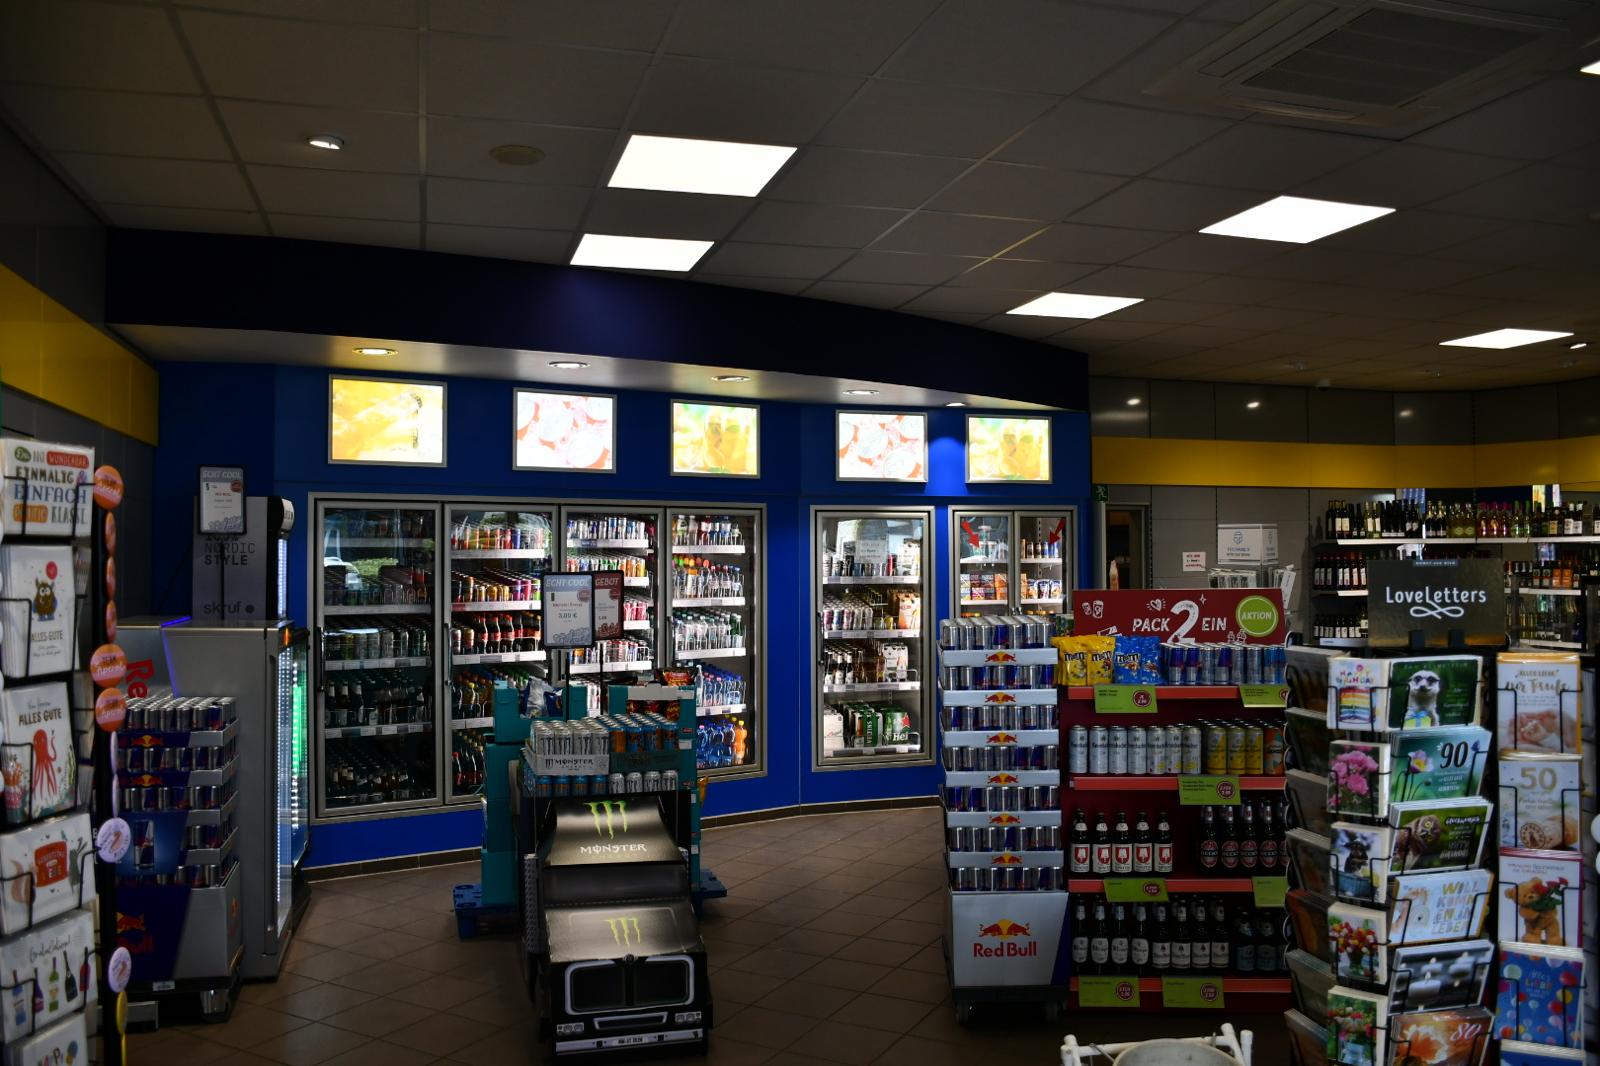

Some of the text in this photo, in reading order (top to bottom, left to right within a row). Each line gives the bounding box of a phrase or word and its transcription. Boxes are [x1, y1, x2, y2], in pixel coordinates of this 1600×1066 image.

[16, 466, 74, 484] EINMALIG
[222, 470, 242, 478] COOL
[204, 543, 256, 554] NORDIC
[204, 554, 248, 566] STYLE
[203, 601, 240, 614] skruf
[1133, 600, 1227, 644] PACK 2 EIN
[1241, 611, 1272, 620] AKTION
[19, 708, 62, 726] ALLES GUTE
[1440, 741, 1469, 769] 90
[555, 758, 594, 766] MONSTER
[1520, 767, 1557, 791] 50
[580, 843, 648, 854] MONSTER
[973, 942, 1037, 957] Red Bull
